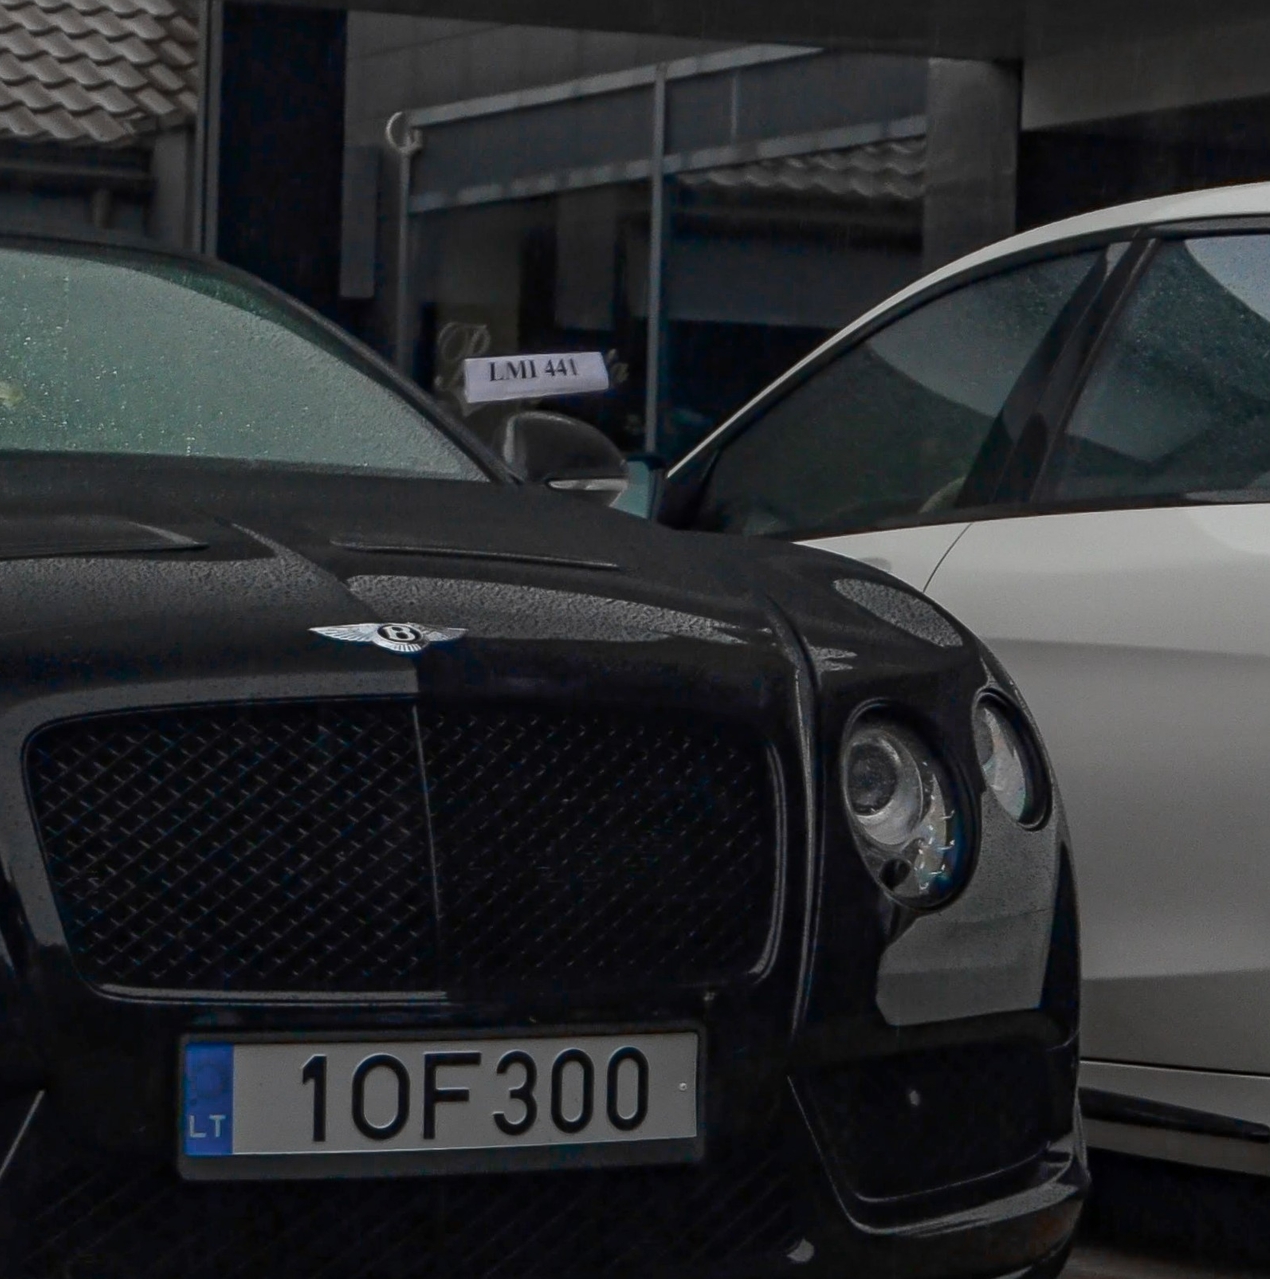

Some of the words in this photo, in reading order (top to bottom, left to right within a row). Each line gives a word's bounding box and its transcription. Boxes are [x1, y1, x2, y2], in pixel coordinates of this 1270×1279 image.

[544, 358, 580, 377] 441
[300, 1045, 649, 1142] 1OF300
[189, 1114, 226, 1139] LT
